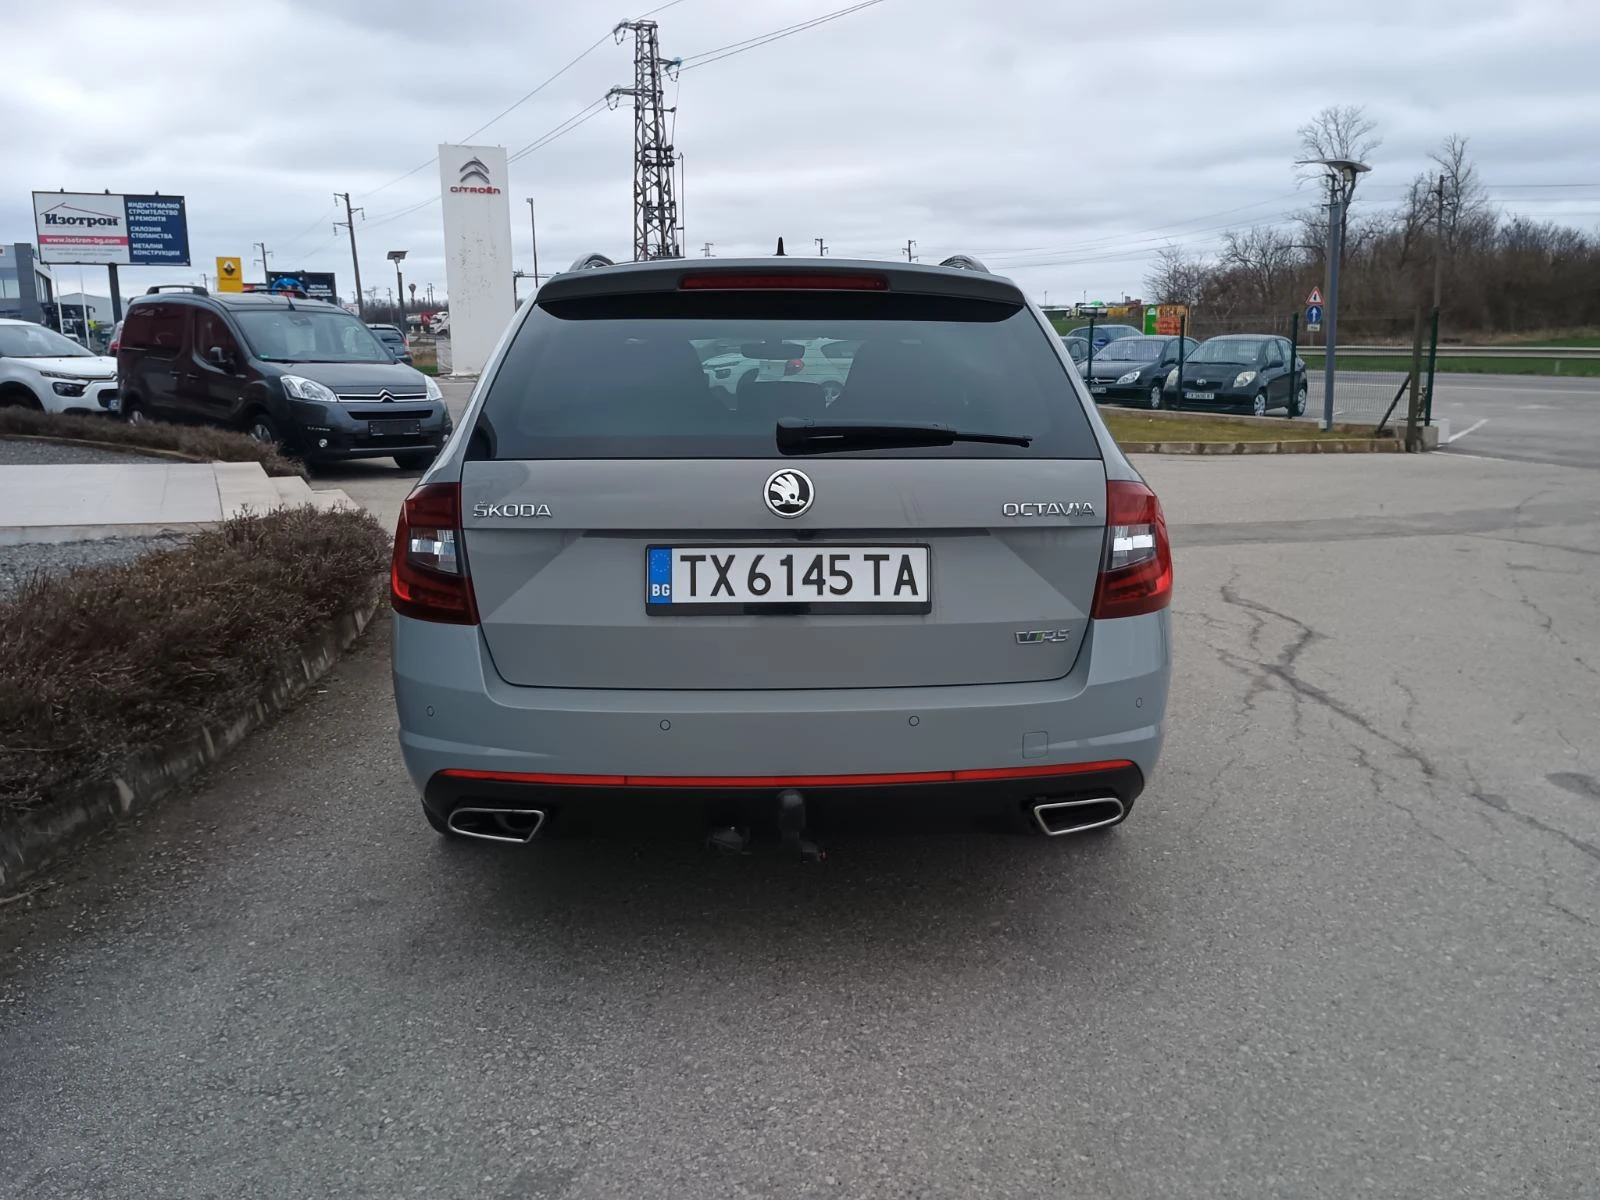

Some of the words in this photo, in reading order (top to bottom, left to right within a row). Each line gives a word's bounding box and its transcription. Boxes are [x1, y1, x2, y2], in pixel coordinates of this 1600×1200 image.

[44, 213, 118, 228] Изотрон
[473, 500, 552, 517] ŠKODA
[1003, 502, 1095, 516] OCTAVIA
[652, 584, 670, 597] BG
